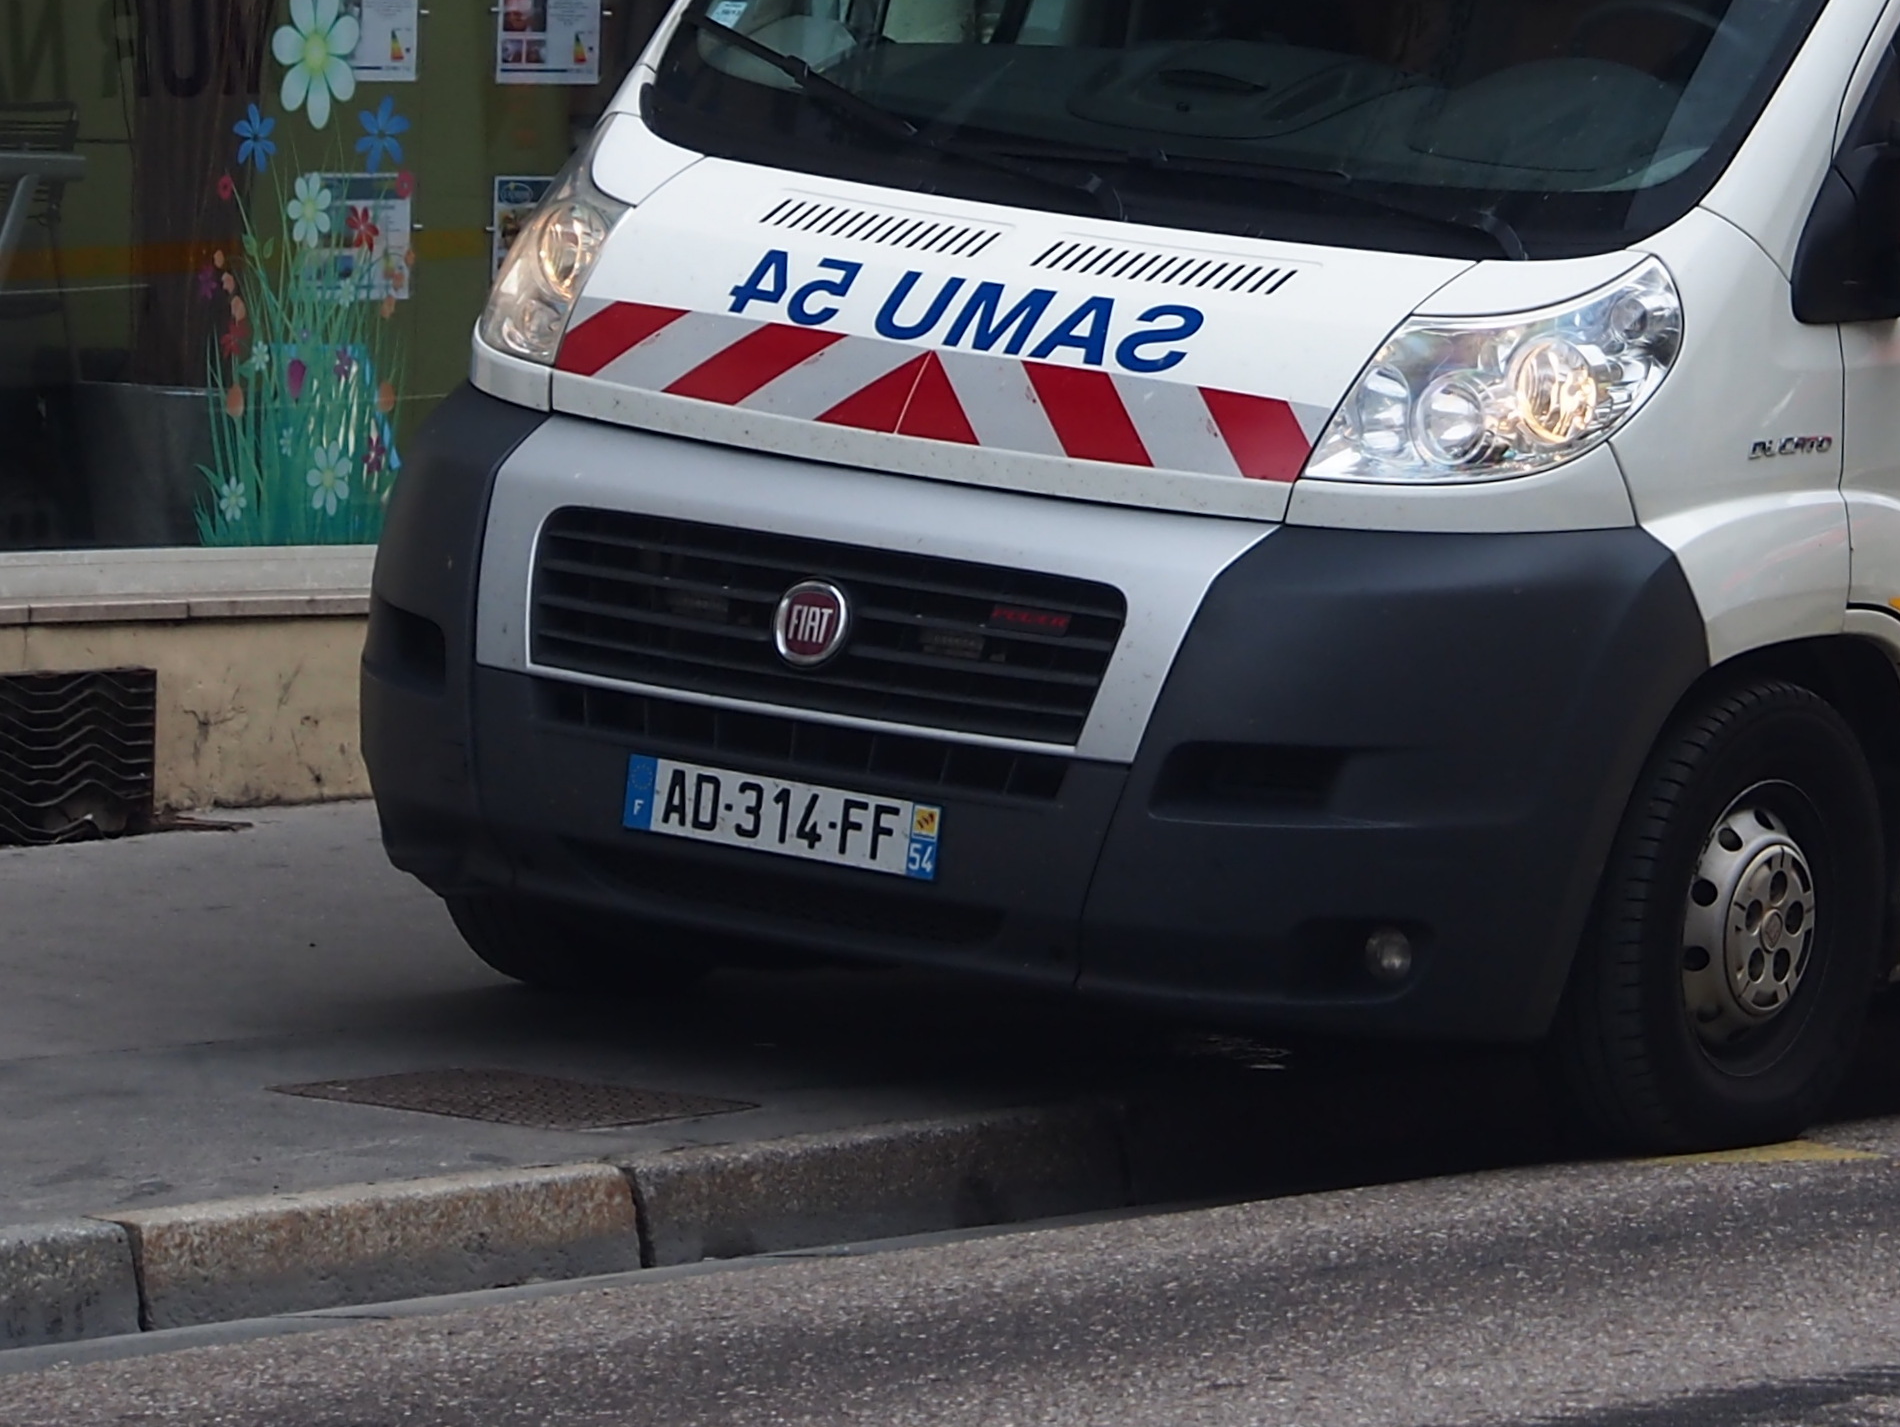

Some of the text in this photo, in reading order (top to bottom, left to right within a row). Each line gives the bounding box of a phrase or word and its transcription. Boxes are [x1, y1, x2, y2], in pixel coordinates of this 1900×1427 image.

[788, 604, 833, 643] FIAT
[632, 799, 644, 815] F
[661, 768, 900, 861] AD-314-FF
[908, 842, 934, 873] 54
